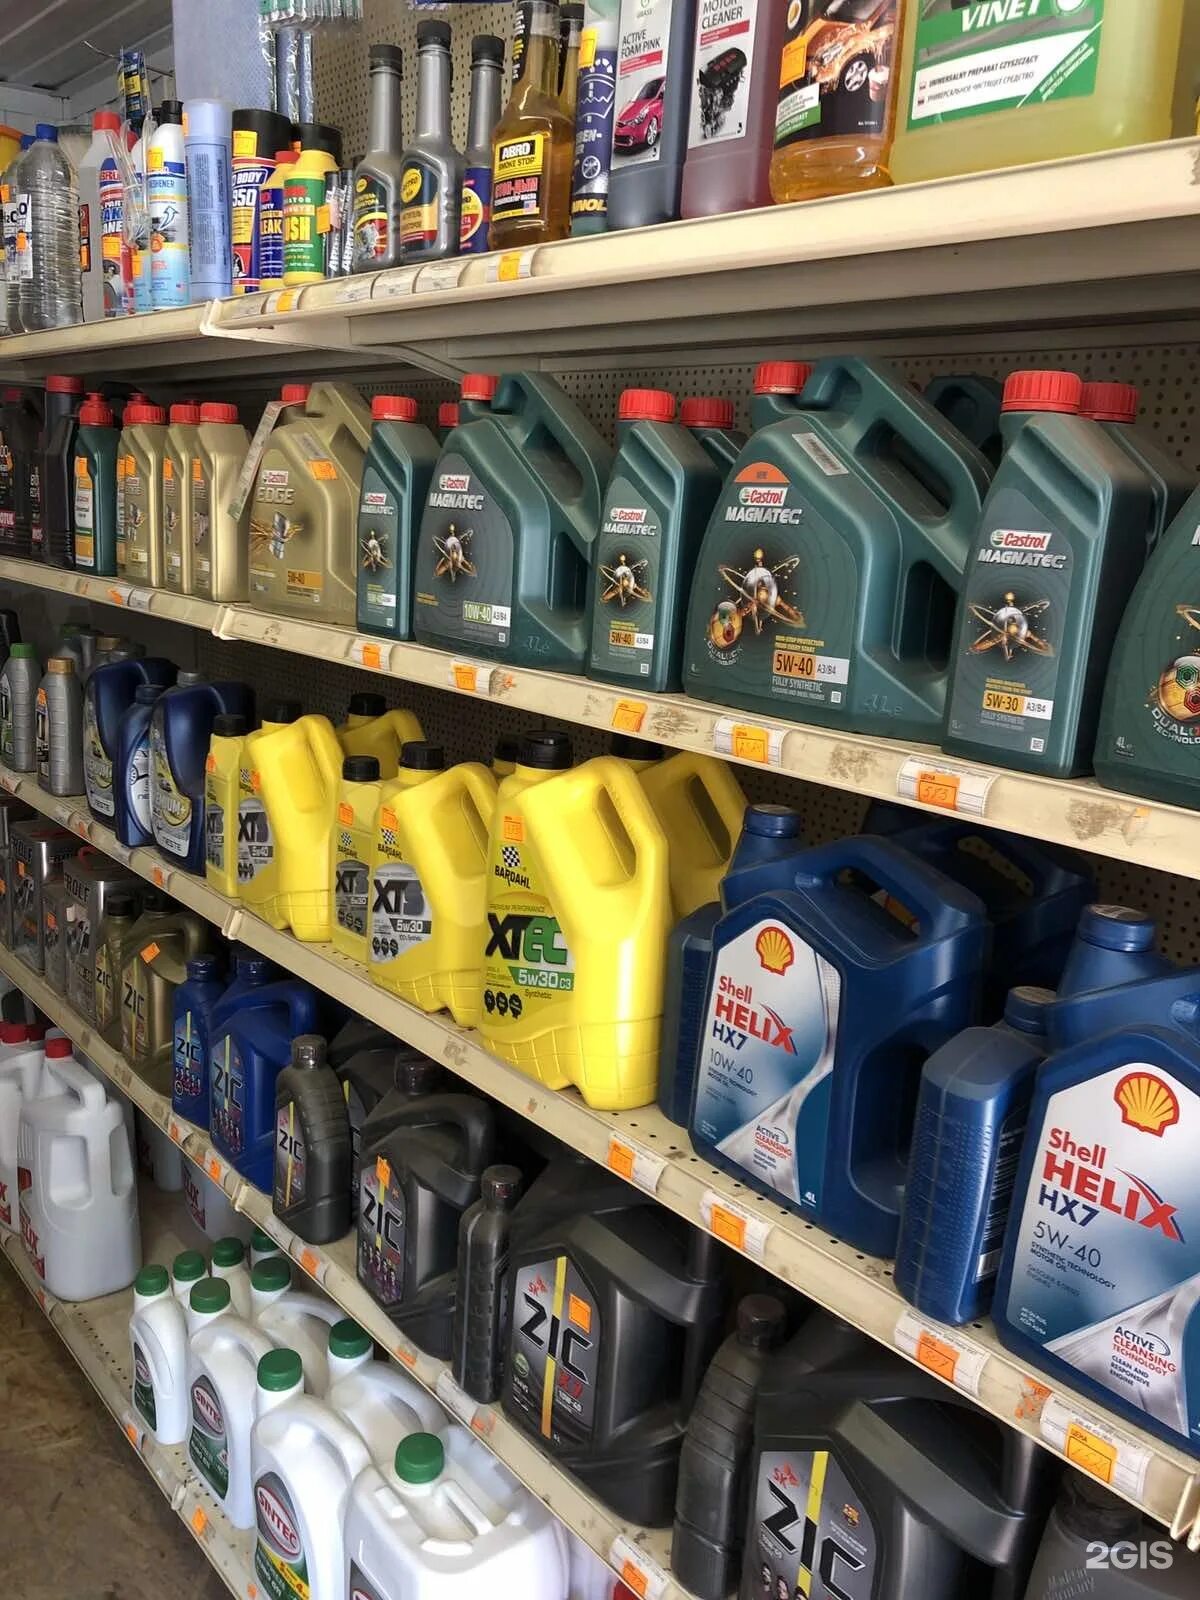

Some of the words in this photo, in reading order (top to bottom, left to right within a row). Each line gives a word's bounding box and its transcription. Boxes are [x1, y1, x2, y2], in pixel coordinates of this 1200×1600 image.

[702, 6, 743, 30] CLEANER
[621, 44, 641, 58] FOAM
[642, 38, 661, 52] PINK
[622, 29, 647, 45] ACTIVE
[928, 72, 967, 87] UNIVERSALNY
[968, 63, 999, 78] PREPARAT
[502, 142, 531, 160] ABRO
[237, 171, 263, 184] BODY
[445, 476, 469, 490] Castrol
[256, 486, 295, 505] EDGE
[429, 493, 484, 511] MAGNATEC
[750, 489, 783, 505] Castrol
[618, 510, 644, 522] Castrol
[725, 507, 803, 525] MAGNATEC
[603, 523, 656, 536] MAGNATEC
[1004, 532, 1048, 549] Castrol
[977, 549, 1068, 569] MAGNATEC
[464, 603, 491, 622] 10W-40
[610, 632, 632, 645] 5W-40
[776, 653, 813, 675] 5W-40
[790, 678, 823, 693] SYNTHETIC
[986, 693, 1019, 712] 5W-30
[65, 872, 91, 903] ROLF
[494, 865, 531, 889] BARDAHL
[396, 921, 423, 932] 5w30
[485, 912, 568, 965] XTEC
[96, 967, 111, 989] ZIC
[518, 969, 558, 988] 5w30
[719, 976, 753, 1004] Shell
[124, 982, 145, 1020] ZIC
[525, 989, 552, 999] Synthetic
[712, 1020, 748, 1050] HX7
[715, 993, 796, 1055] HELIX
[176, 1038, 201, 1063] ZIC
[710, 1048, 753, 1084] 10W-40
[213, 1062, 243, 1110] ZIC
[279, 1130, 303, 1161] ZIC
[755, 1132, 792, 1157] CLEANSING
[756, 1125, 780, 1142] ACTIVE
[1048, 1127, 1107, 1170] Shell
[1038, 1183, 1100, 1228] HX7
[1043, 1149, 1182, 1245] HELIX
[363, 1185, 403, 1254] ZIC
[1033, 1221, 1102, 1268] 5W-40
[1030, 1248, 1054, 1268] MOTOR
[1056, 1262, 1067, 1273] OIL
[1031, 1241, 1065, 1265] SYNTHETIC
[1067, 1262, 1116, 1290] TECHNOLOGY
[519, 1291, 593, 1386] ZIC
[1115, 1326, 1155, 1351] ACTIVE
[1111, 1354, 1133, 1370] CLEAN
[1133, 1366, 1150, 1378] AND
[1112, 1344, 1167, 1377] TECHNOLOGY
[1113, 1335, 1177, 1373] CLEANSING
[1109, 1369, 1134, 1387] ENGINE
[1110, 1362, 1150, 1388] RESPONSIVE
[195, 1389, 223, 1427] SINTEC
[259, 1489, 297, 1550] SINTEC
[761, 1478, 866, 1600] ZIC
